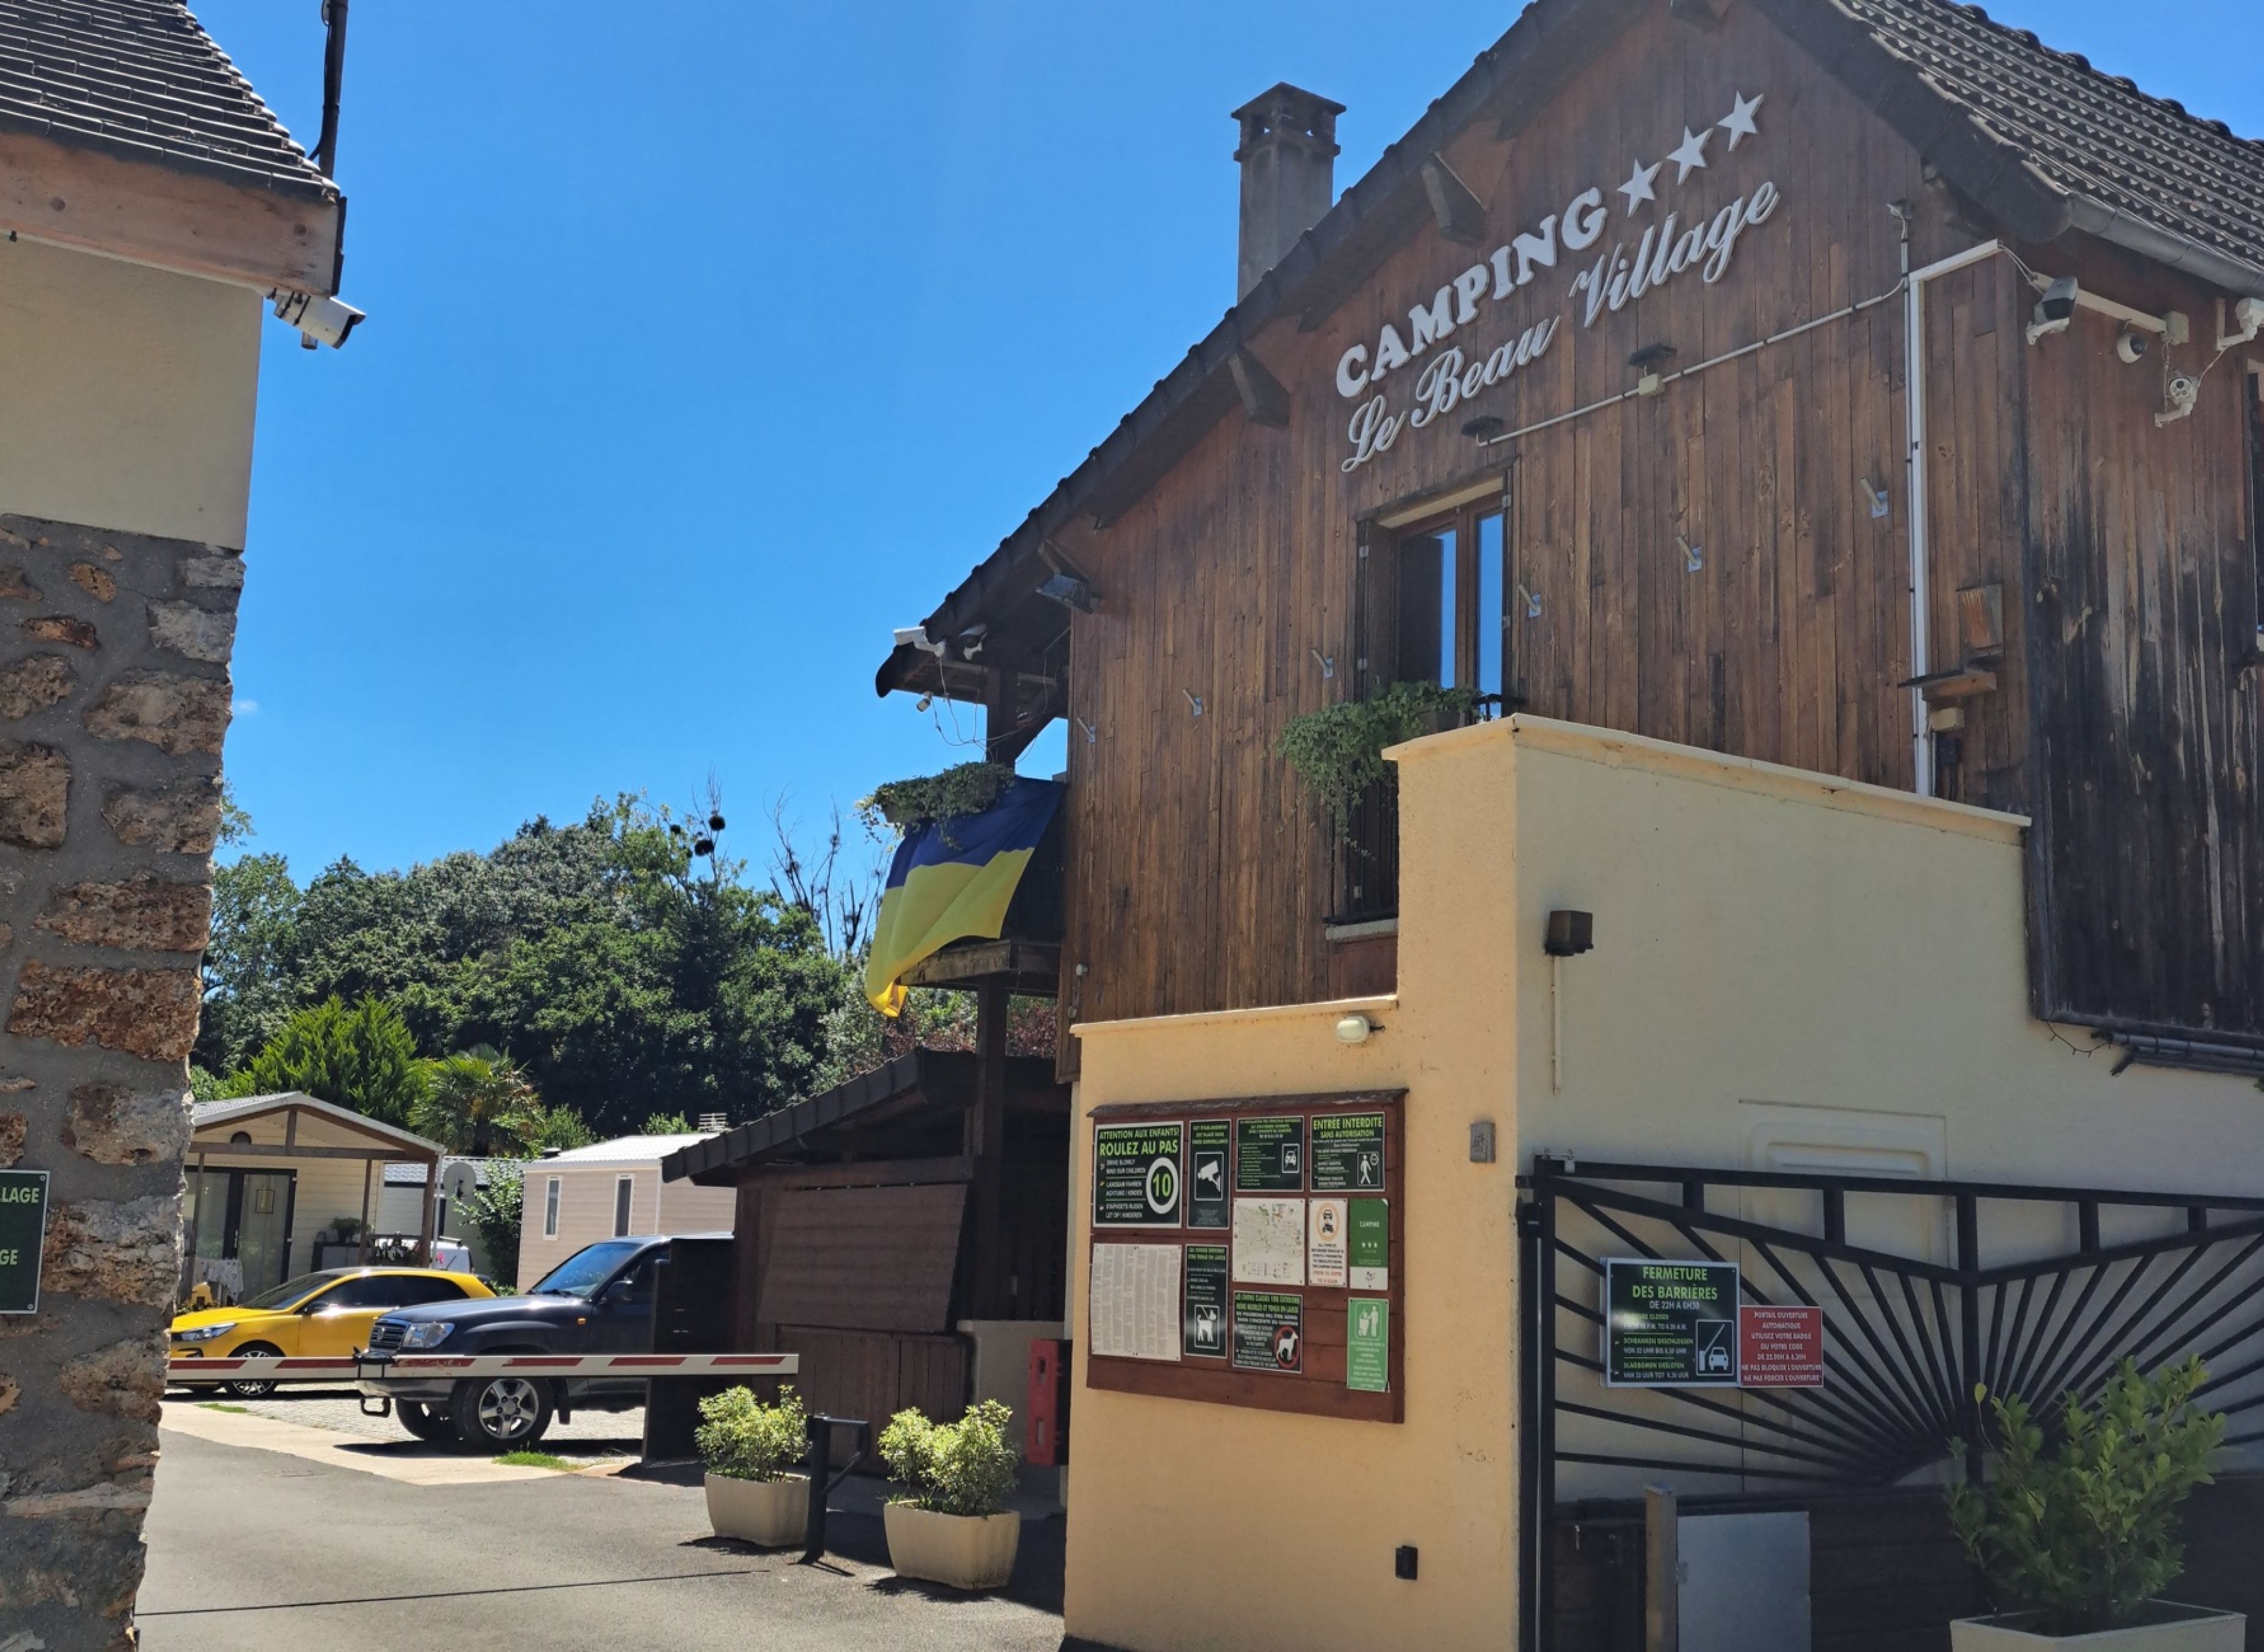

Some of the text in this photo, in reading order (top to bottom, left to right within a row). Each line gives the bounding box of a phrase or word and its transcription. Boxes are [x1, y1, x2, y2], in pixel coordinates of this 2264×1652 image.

[1335, 185, 1609, 398] CAMPING
[1341, 181, 1781, 473] Le Beau Village
[1342, 1117, 1382, 1128] INTERDITE
[1099, 1130, 1133, 1139] ATTENTION
[1134, 1129, 1149, 1138] AUX
[1336, 1129, 1374, 1138] AUTORISATION
[1100, 1139, 1179, 1156] ROULEZ AU PAS
[1153, 1174, 1172, 1197] 10
[0, 1186, 40, 1204] LAGE
[1642, 1267, 1707, 1280] FERMETURE
[1633, 1284, 1718, 1300] DES BARRIÈRES
